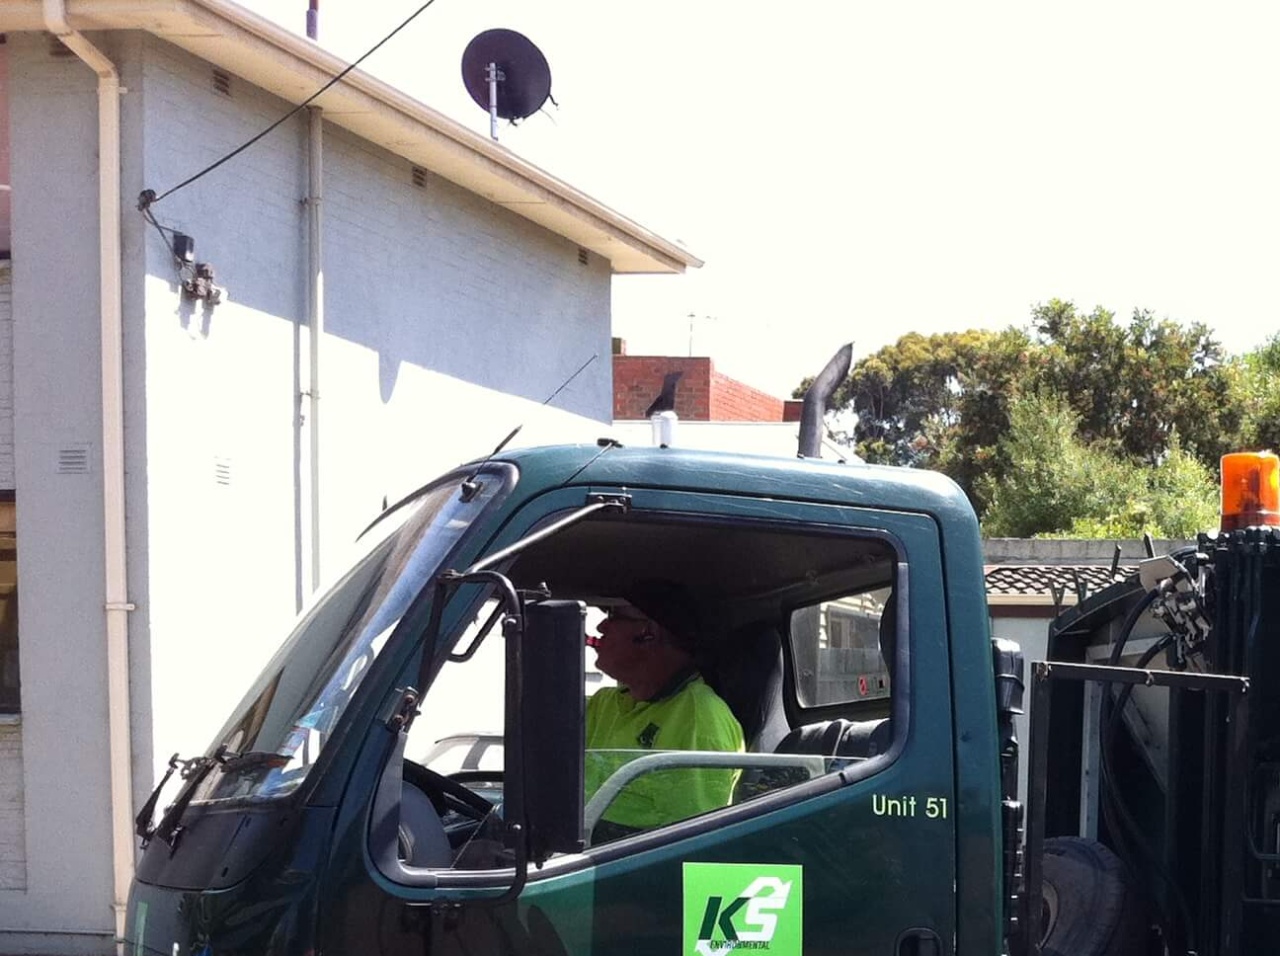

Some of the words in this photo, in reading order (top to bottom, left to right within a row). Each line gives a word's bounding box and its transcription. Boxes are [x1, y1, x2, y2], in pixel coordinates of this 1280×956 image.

[872, 794, 917, 817] Unit
[925, 797, 948, 819] 51
[697, 878, 792, 942] KS
[709, 940, 771, 950] ENVIRONMENTAL
